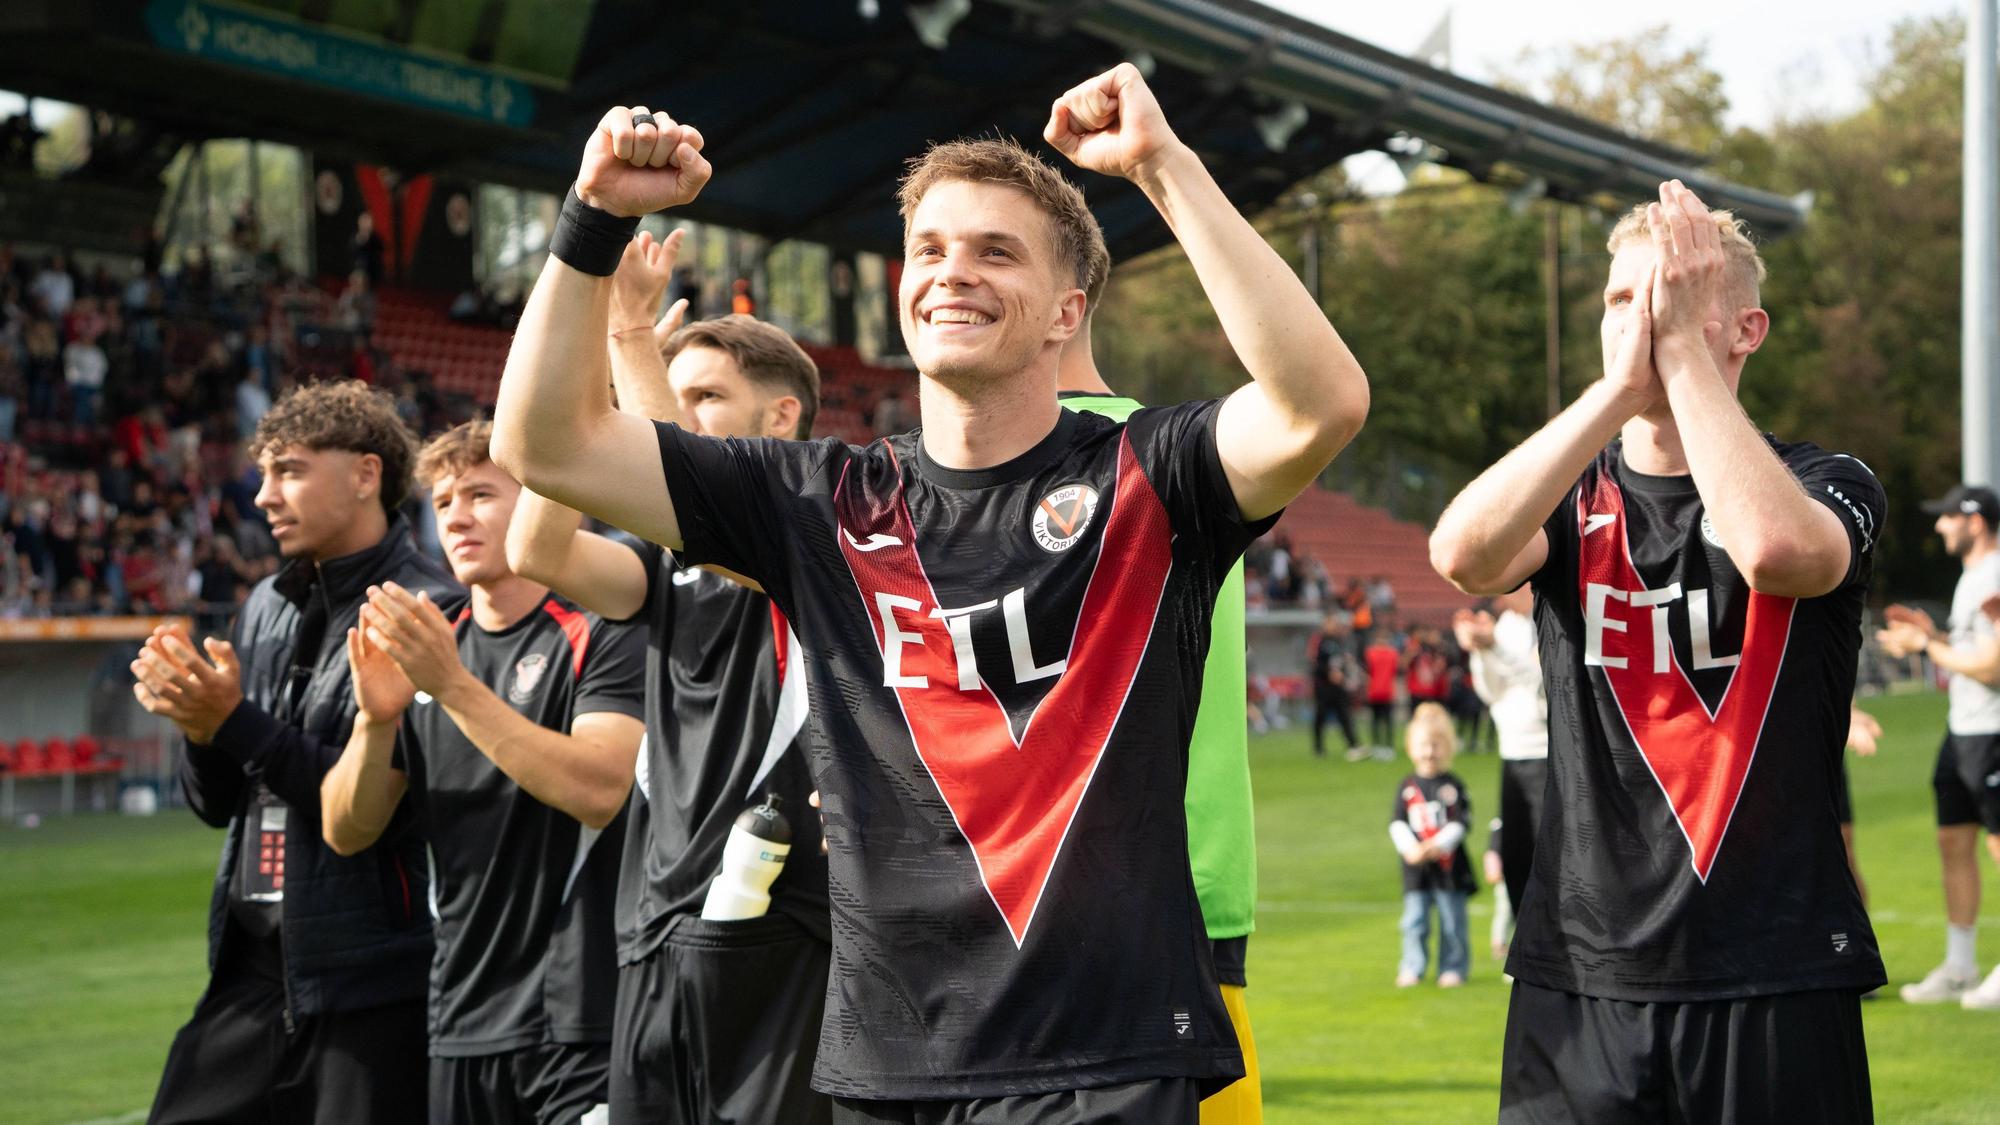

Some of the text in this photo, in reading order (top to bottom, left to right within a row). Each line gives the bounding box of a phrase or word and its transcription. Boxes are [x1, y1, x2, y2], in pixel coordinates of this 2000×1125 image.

[1053, 488, 1076, 501] 1904
[1034, 521, 1079, 550] VIKTORIA
[874, 586, 1067, 691] ETL
[1584, 582, 1741, 674] ETL
